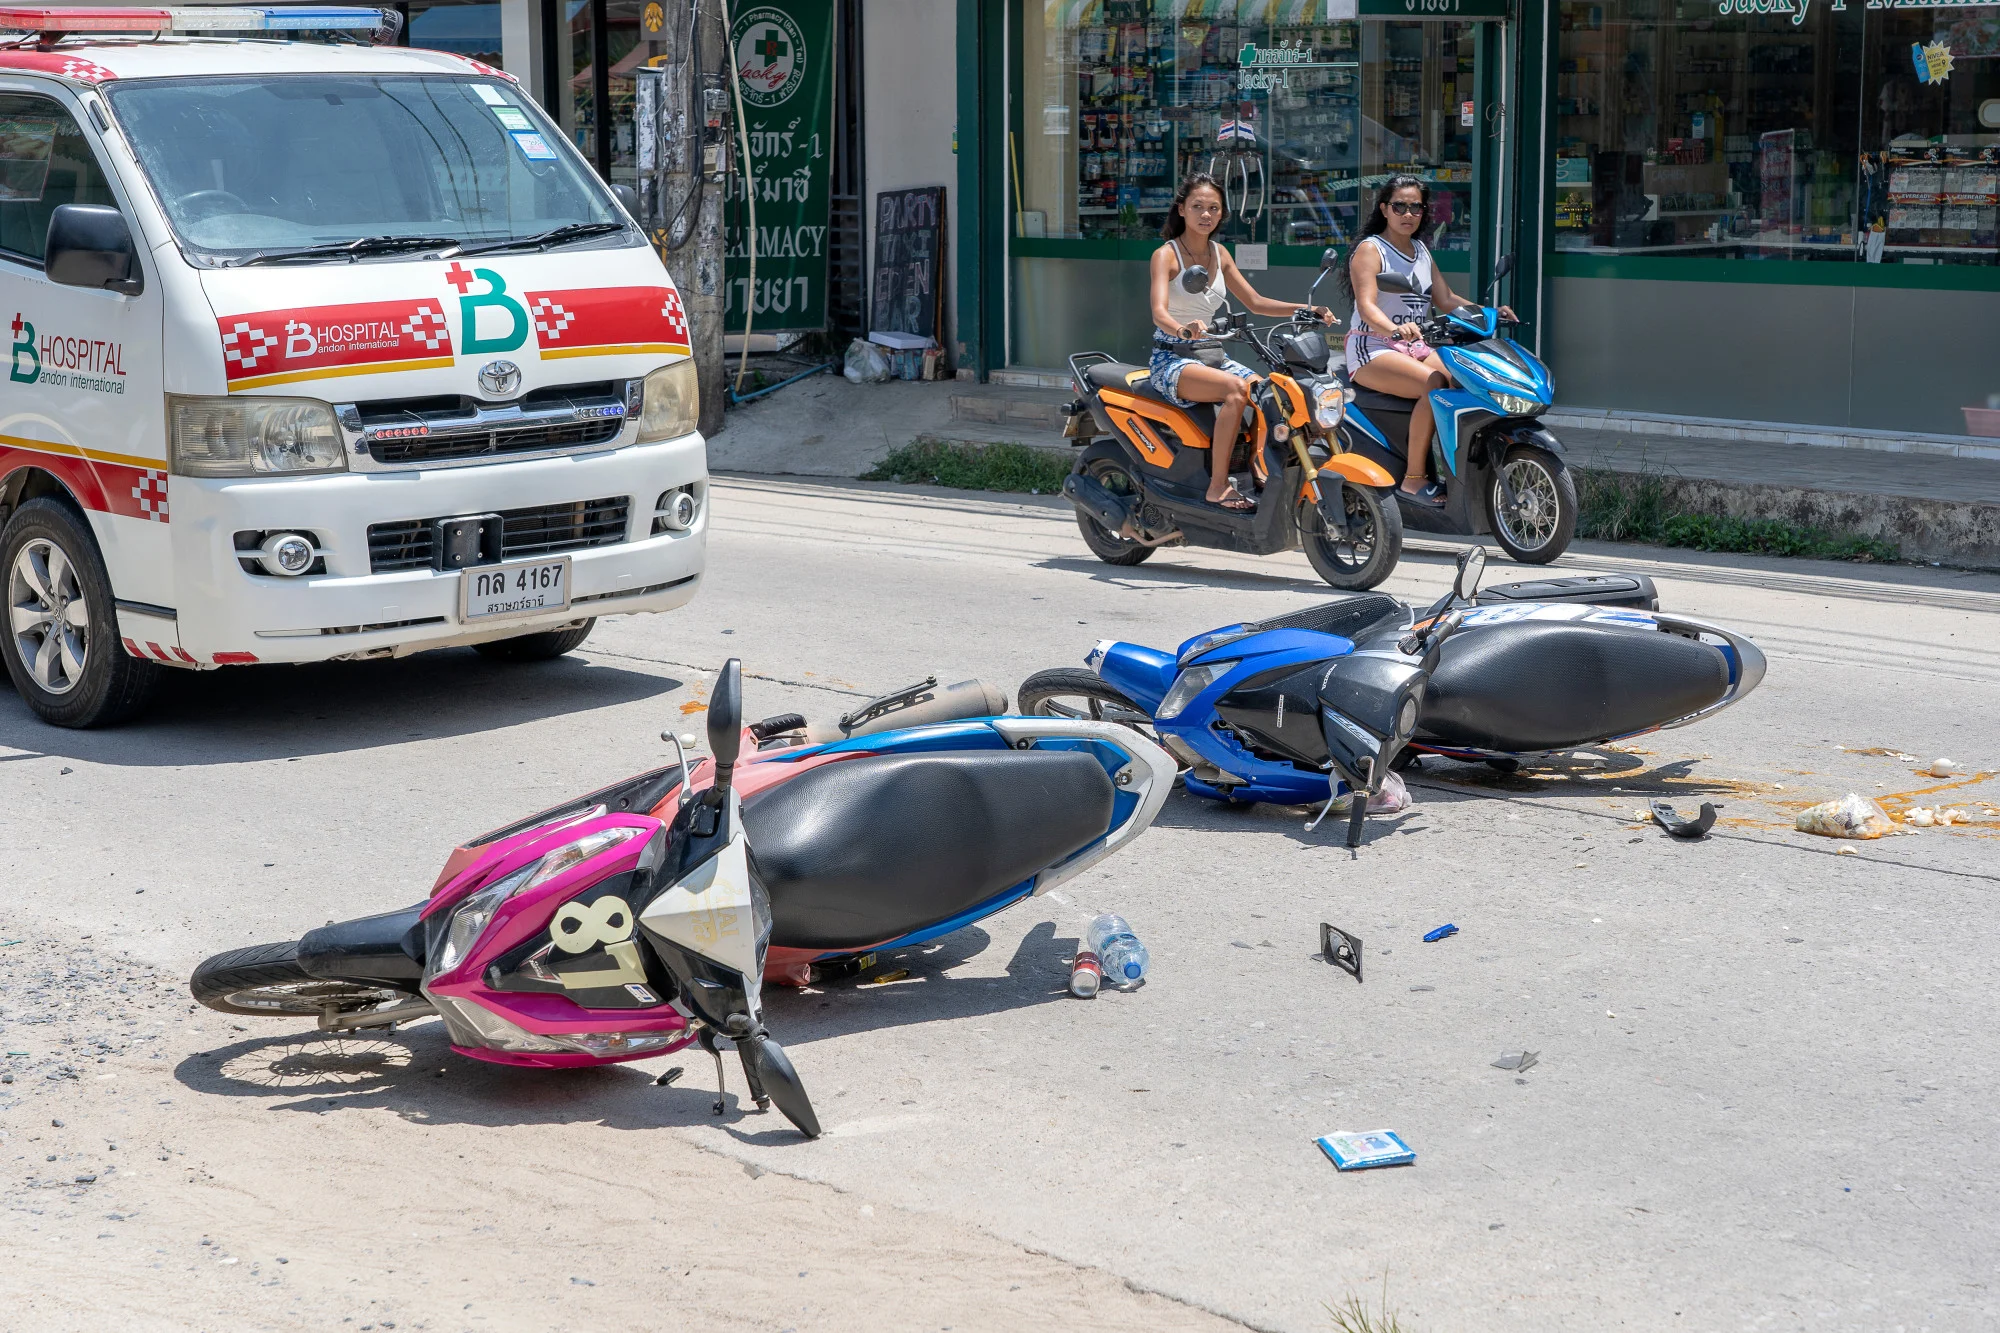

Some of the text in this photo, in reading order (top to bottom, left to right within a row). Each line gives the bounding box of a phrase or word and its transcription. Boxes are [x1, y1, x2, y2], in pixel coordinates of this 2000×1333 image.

[1237, 67, 1289, 95] Jacky-1
[317, 321, 400, 344] HOSPITAL
[348, 338, 400, 351] international
[40, 334, 127, 376] HOSPITAL
[70, 372, 126, 395] international
[477, 564, 563, 597] กล 4167
